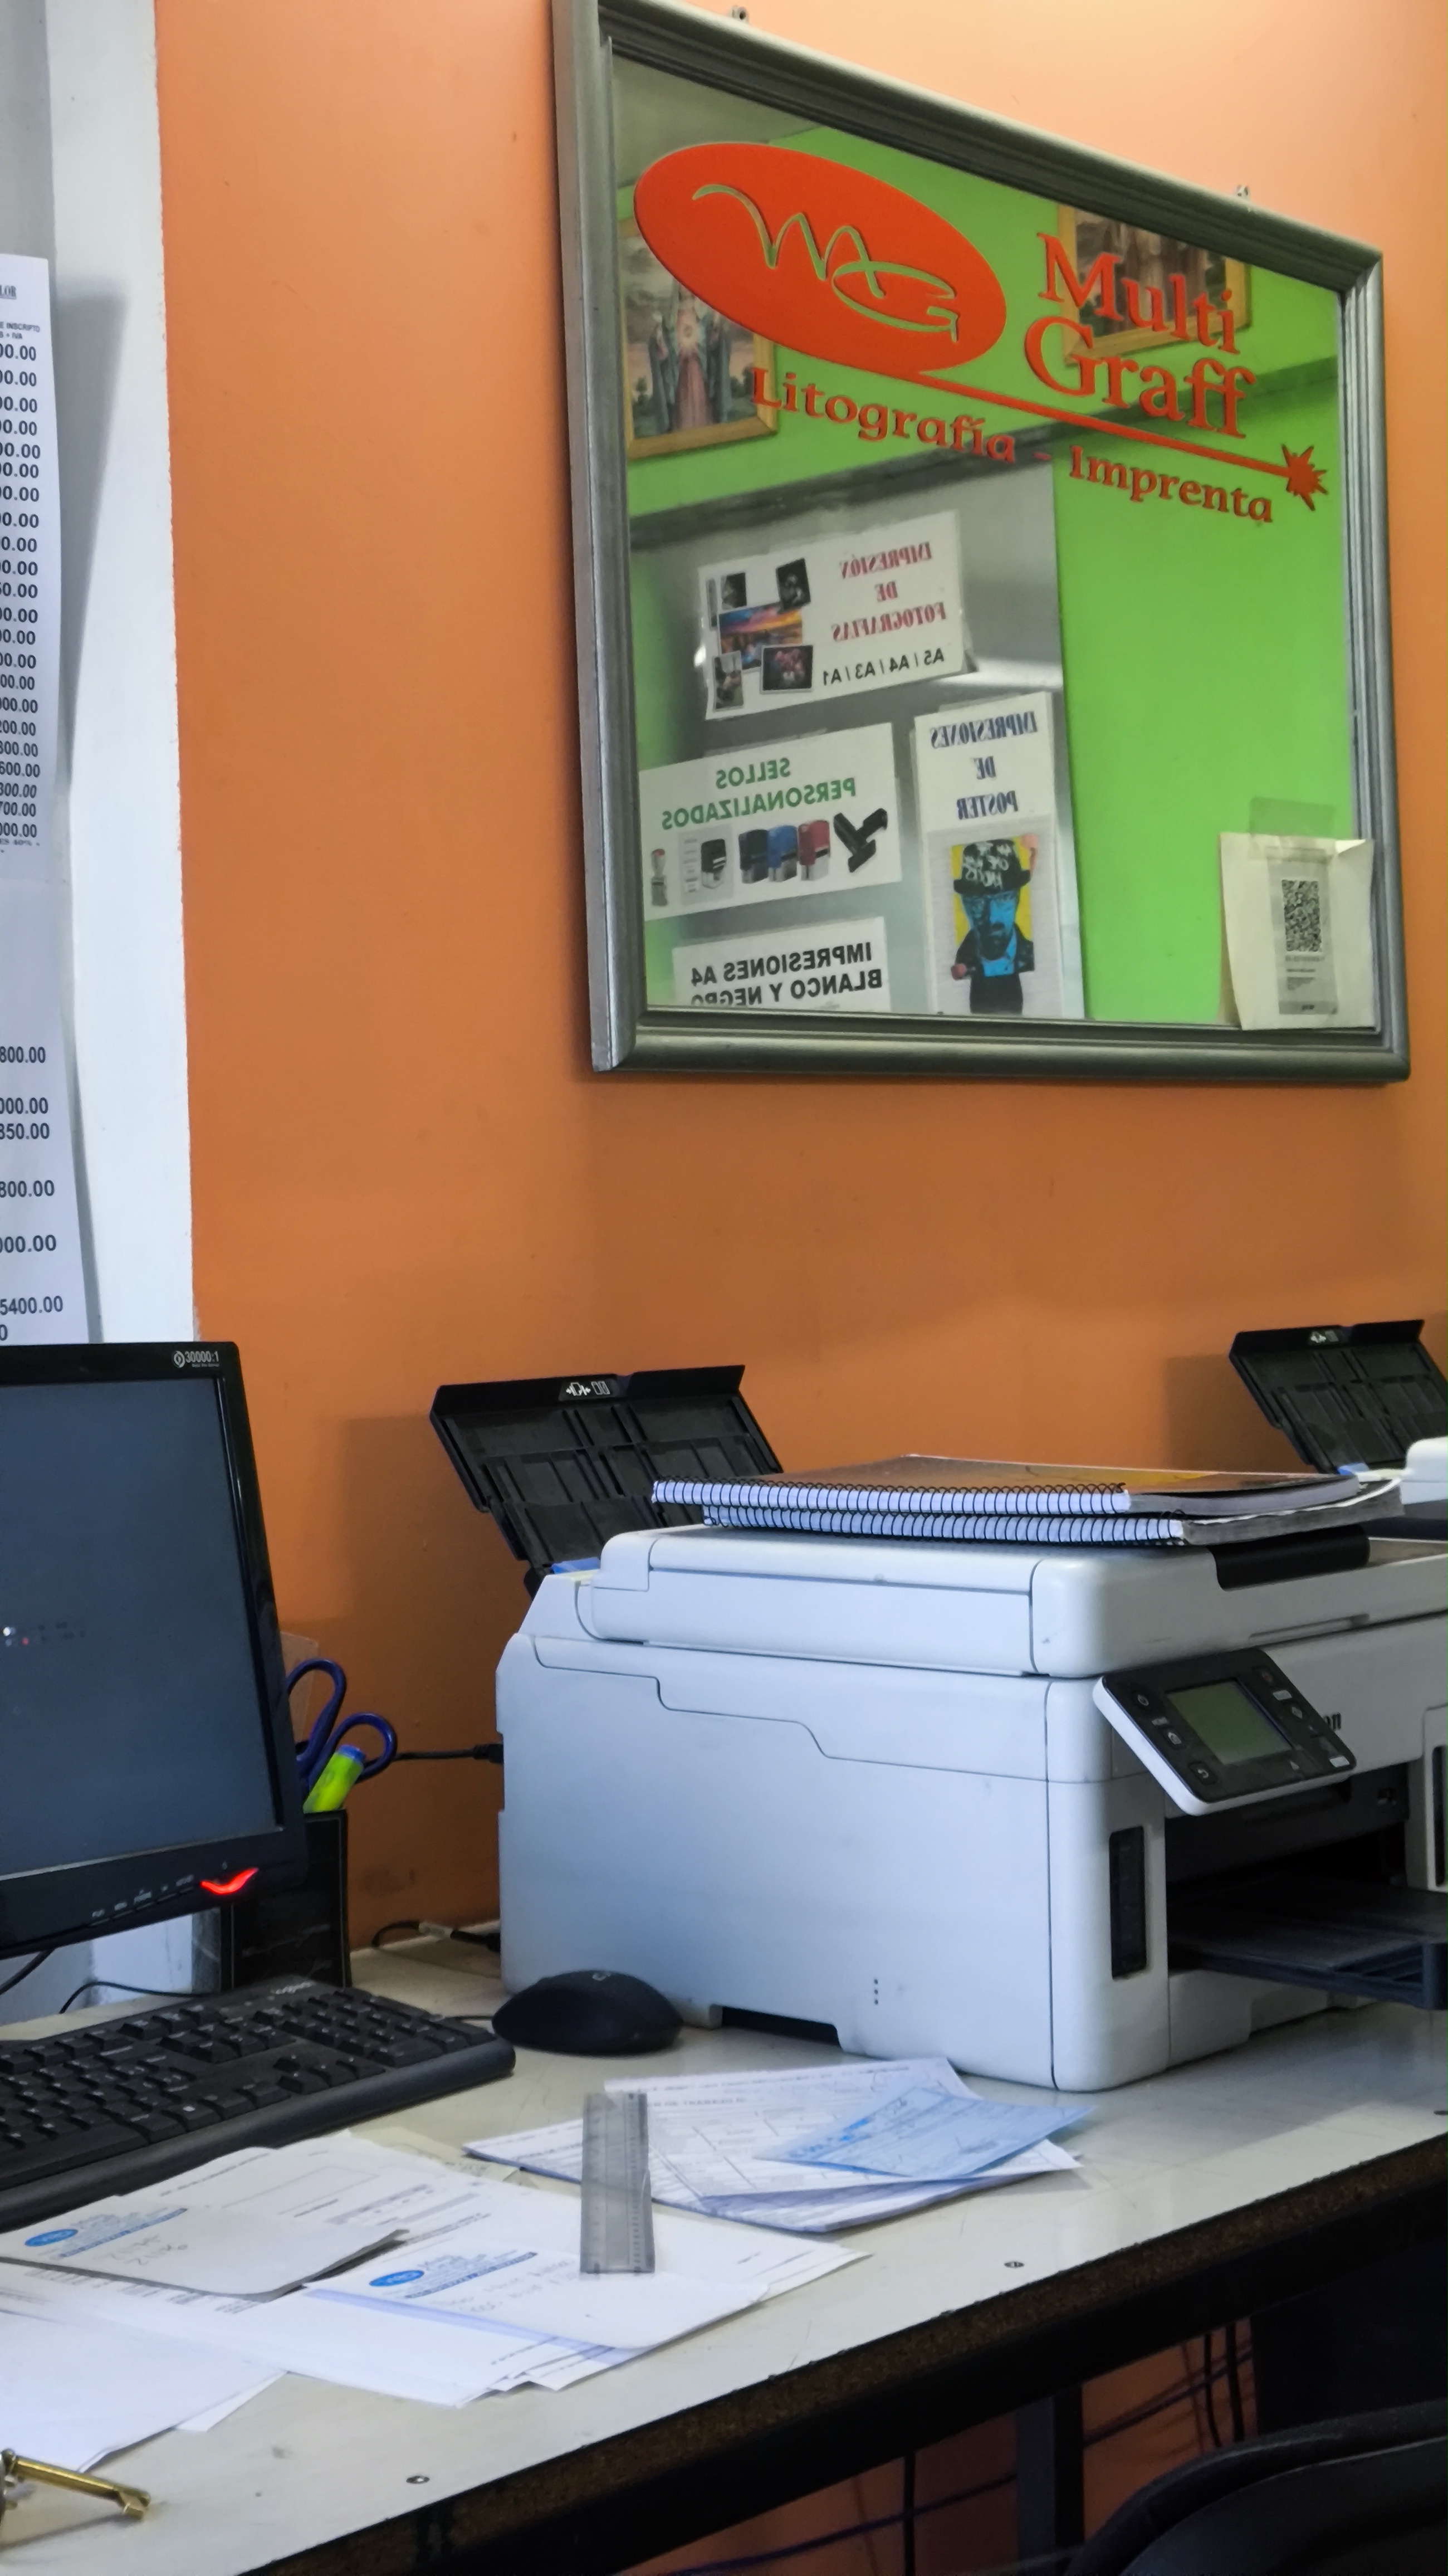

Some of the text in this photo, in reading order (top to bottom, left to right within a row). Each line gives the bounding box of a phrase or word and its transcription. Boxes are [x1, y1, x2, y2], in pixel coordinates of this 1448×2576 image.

[1037, 232, 1240, 355] Multi
[1024, 315, 1256, 439] Graff
[751, 367, 1015, 463] Litografía
[1070, 445, 1273, 523] Imprenta
[0, 1046, 46, 1063] 800.00
[0, 1180, 55, 1198] 800.00
